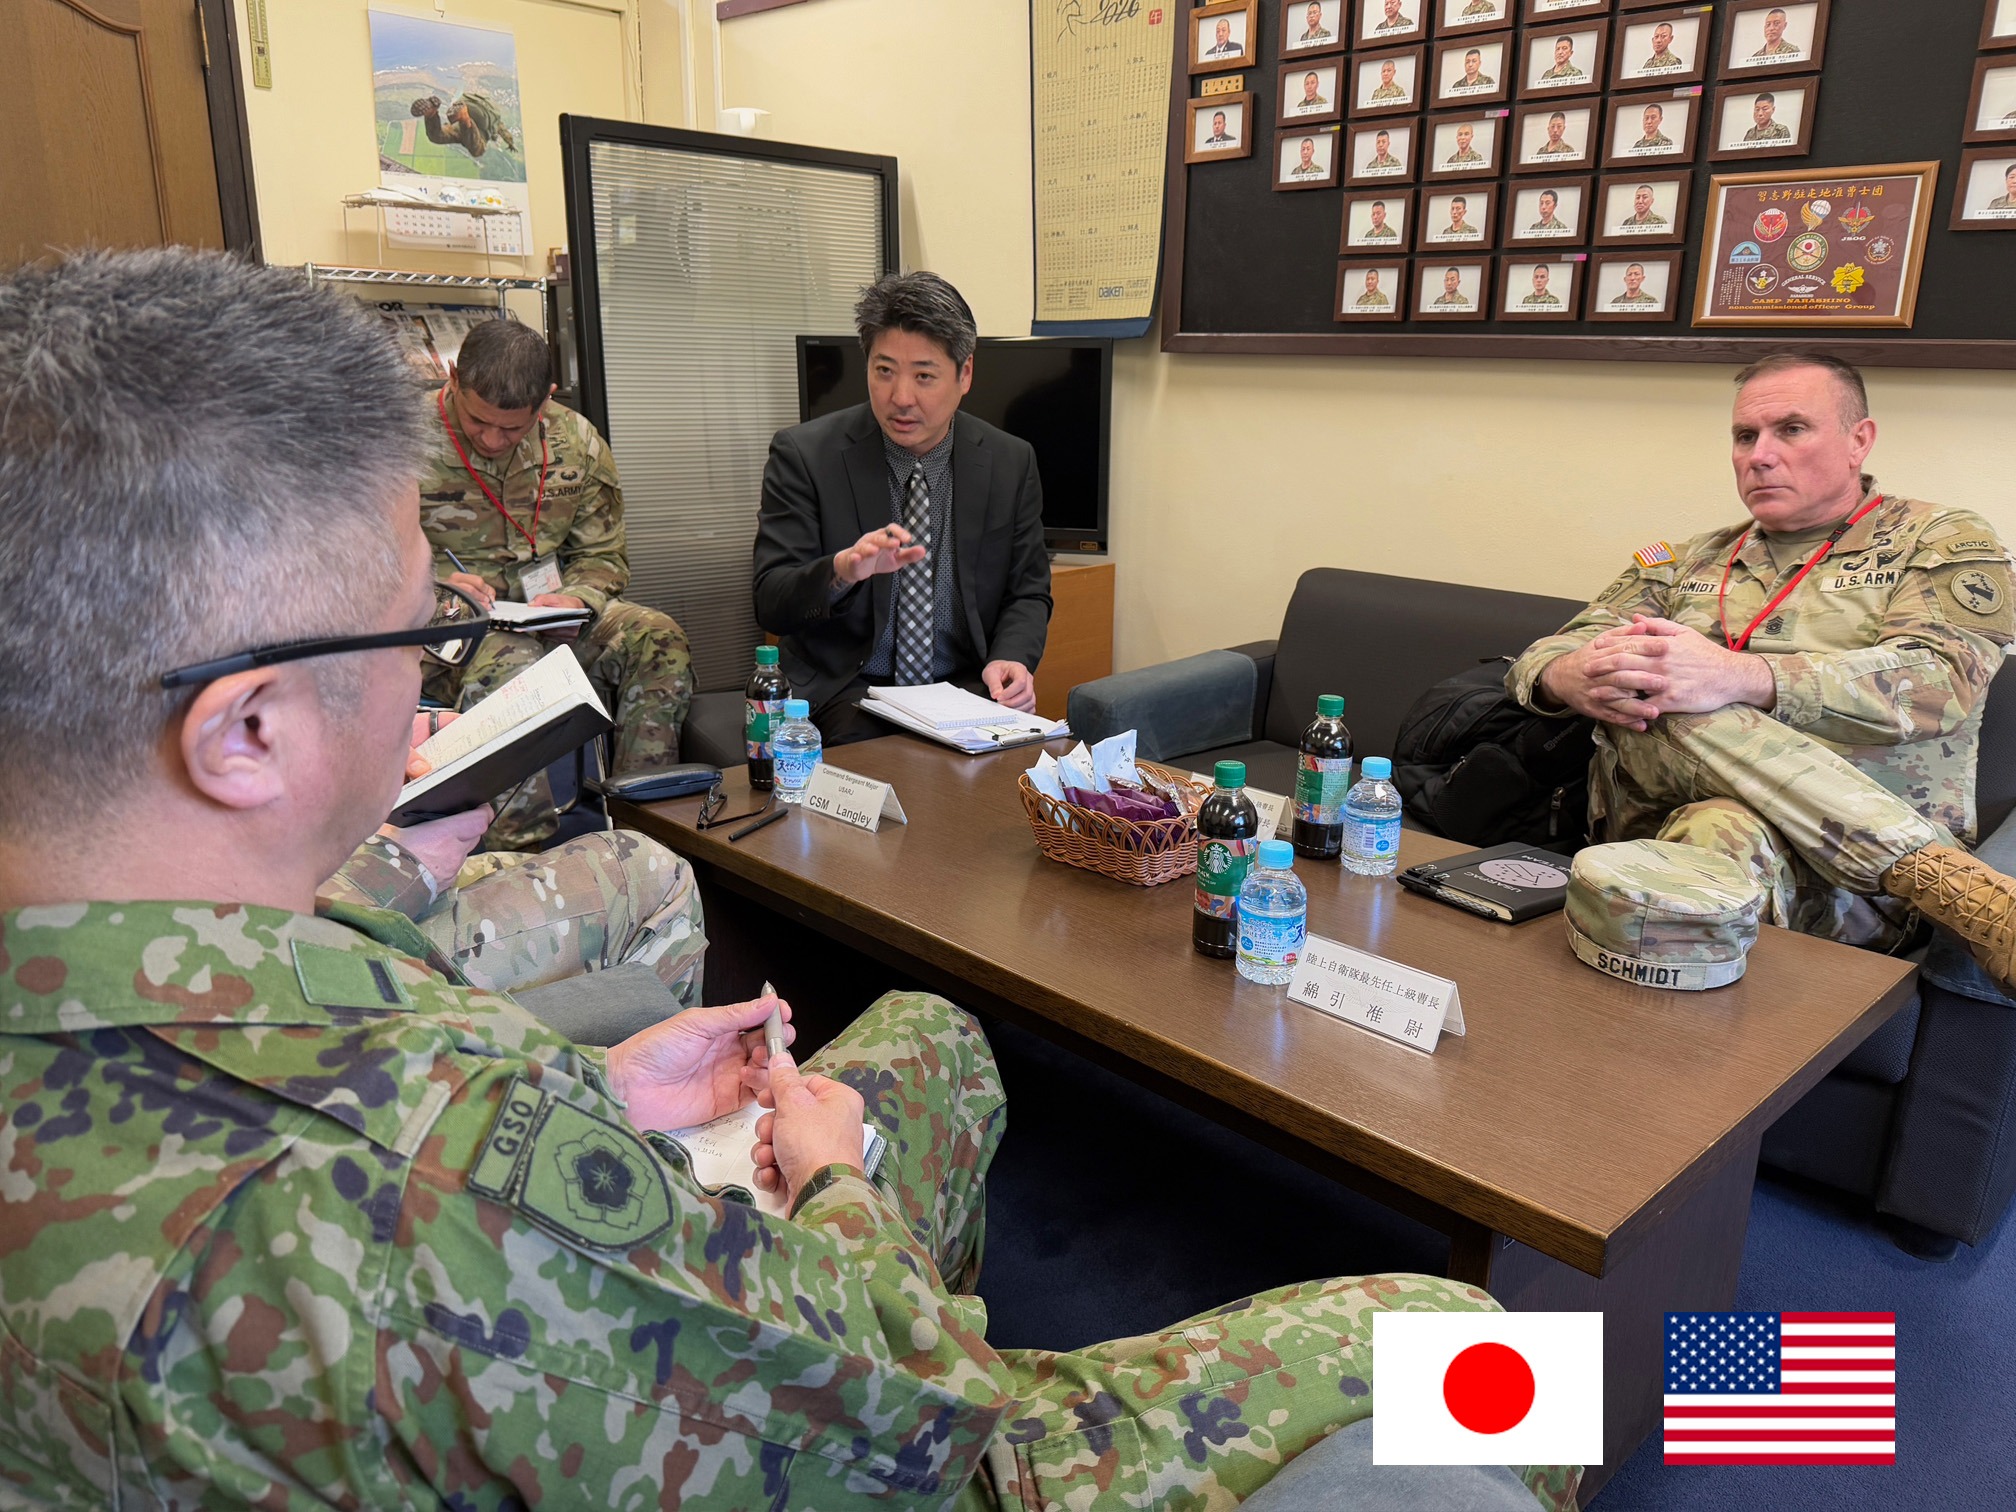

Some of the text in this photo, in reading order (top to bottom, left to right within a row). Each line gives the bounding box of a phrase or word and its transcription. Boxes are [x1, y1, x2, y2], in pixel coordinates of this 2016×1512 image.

[1781, 274, 1826, 286] GENERAL SERVICE
[1954, 540, 1989, 549] ARCTIC
[1680, 581, 1717, 593] HMIDT
[1834, 575, 1861, 588] U.S.
[777, 759, 812, 773] 天然水
[822, 767, 878, 791] Command Sergeant Major
[839, 786, 854, 796] USARJ
[810, 795, 872, 829] CSM Langley
[1521, 854, 1555, 867] TEAM
[1464, 871, 1522, 893] USARPAC
[1598, 953, 1681, 988] SCHMIDT
[1306, 952, 1440, 1010] 陸上自衛隊最先任上級曹長
[493, 1100, 533, 1156] GSO
